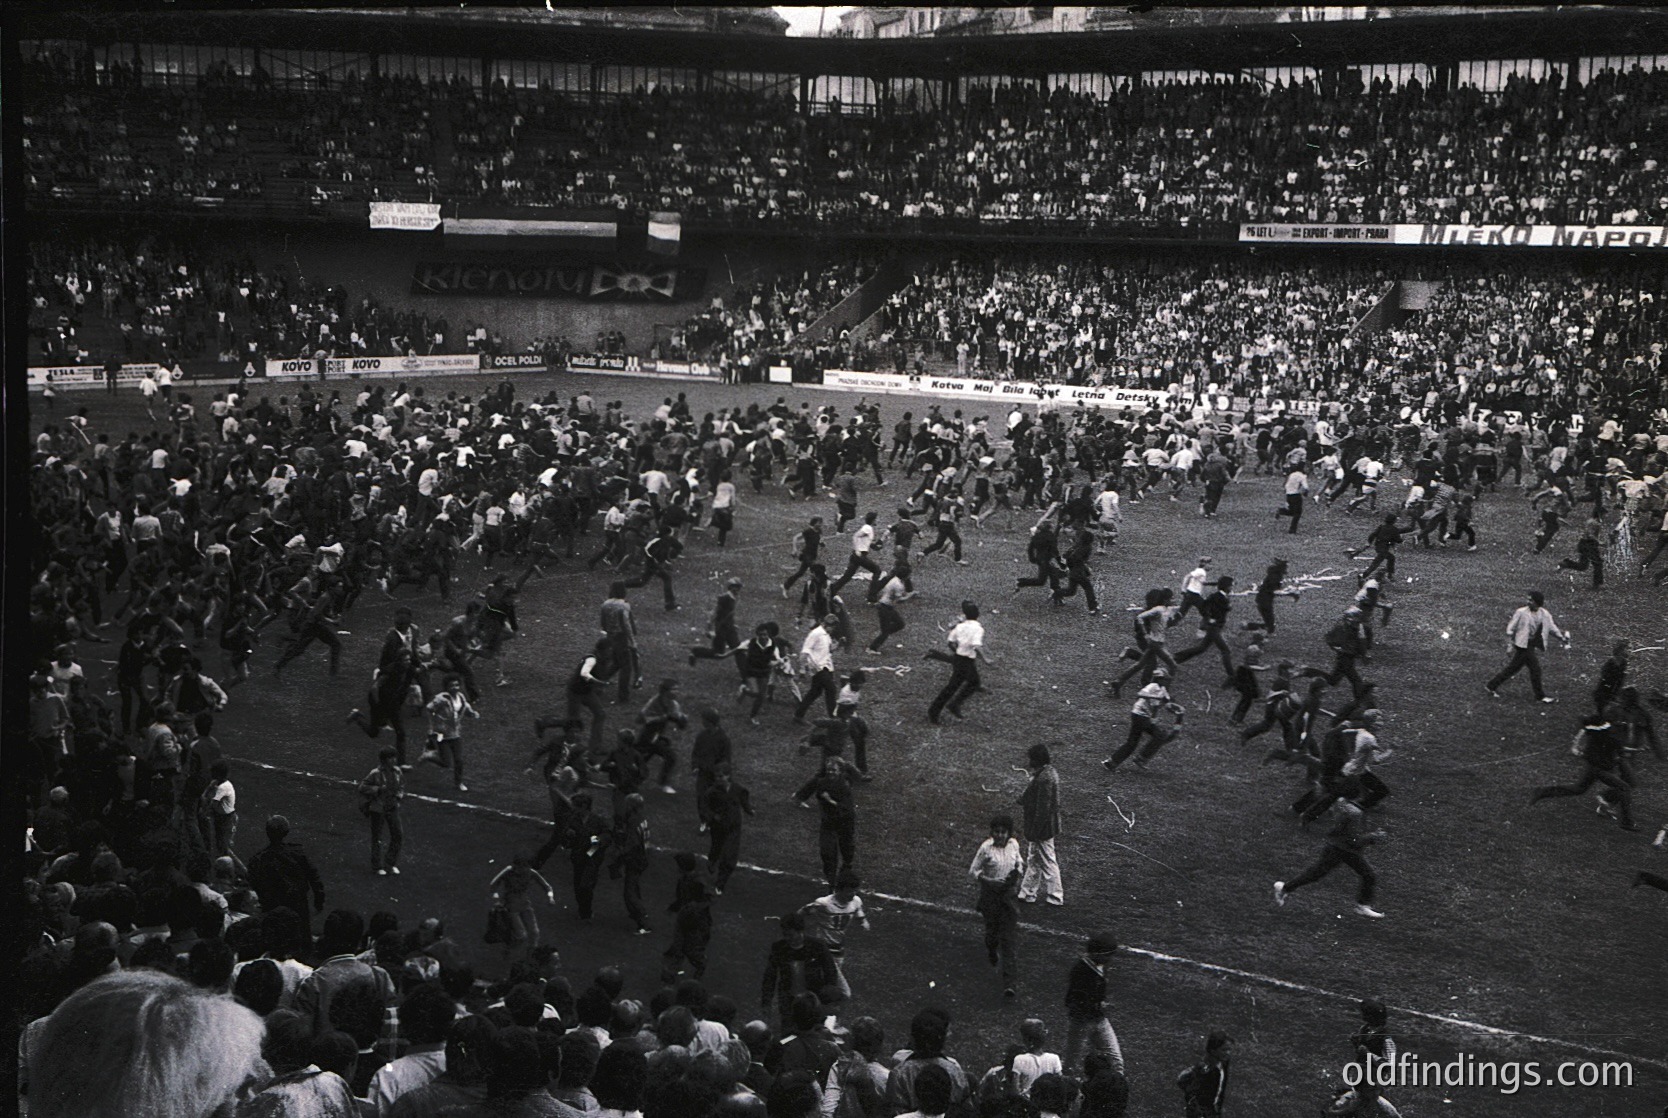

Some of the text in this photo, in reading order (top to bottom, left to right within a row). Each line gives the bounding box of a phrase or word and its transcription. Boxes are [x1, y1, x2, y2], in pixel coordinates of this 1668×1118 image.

[1303, 227, 1328, 239] EXPORT
[1333, 228, 1361, 239] IMPORT
[1365, 228, 1389, 239] PRAHA
[352, 359, 381, 369] KOVO
[494, 355, 542, 366] OCEL POLDI
[281, 361, 312, 372] KOVO
[656, 360, 690, 374] Havana
[691, 362, 710, 375] Club
[47, 368, 75, 377] TESLA
[931, 380, 964, 390] Kotva
[1072, 390, 1105, 400] Letna
